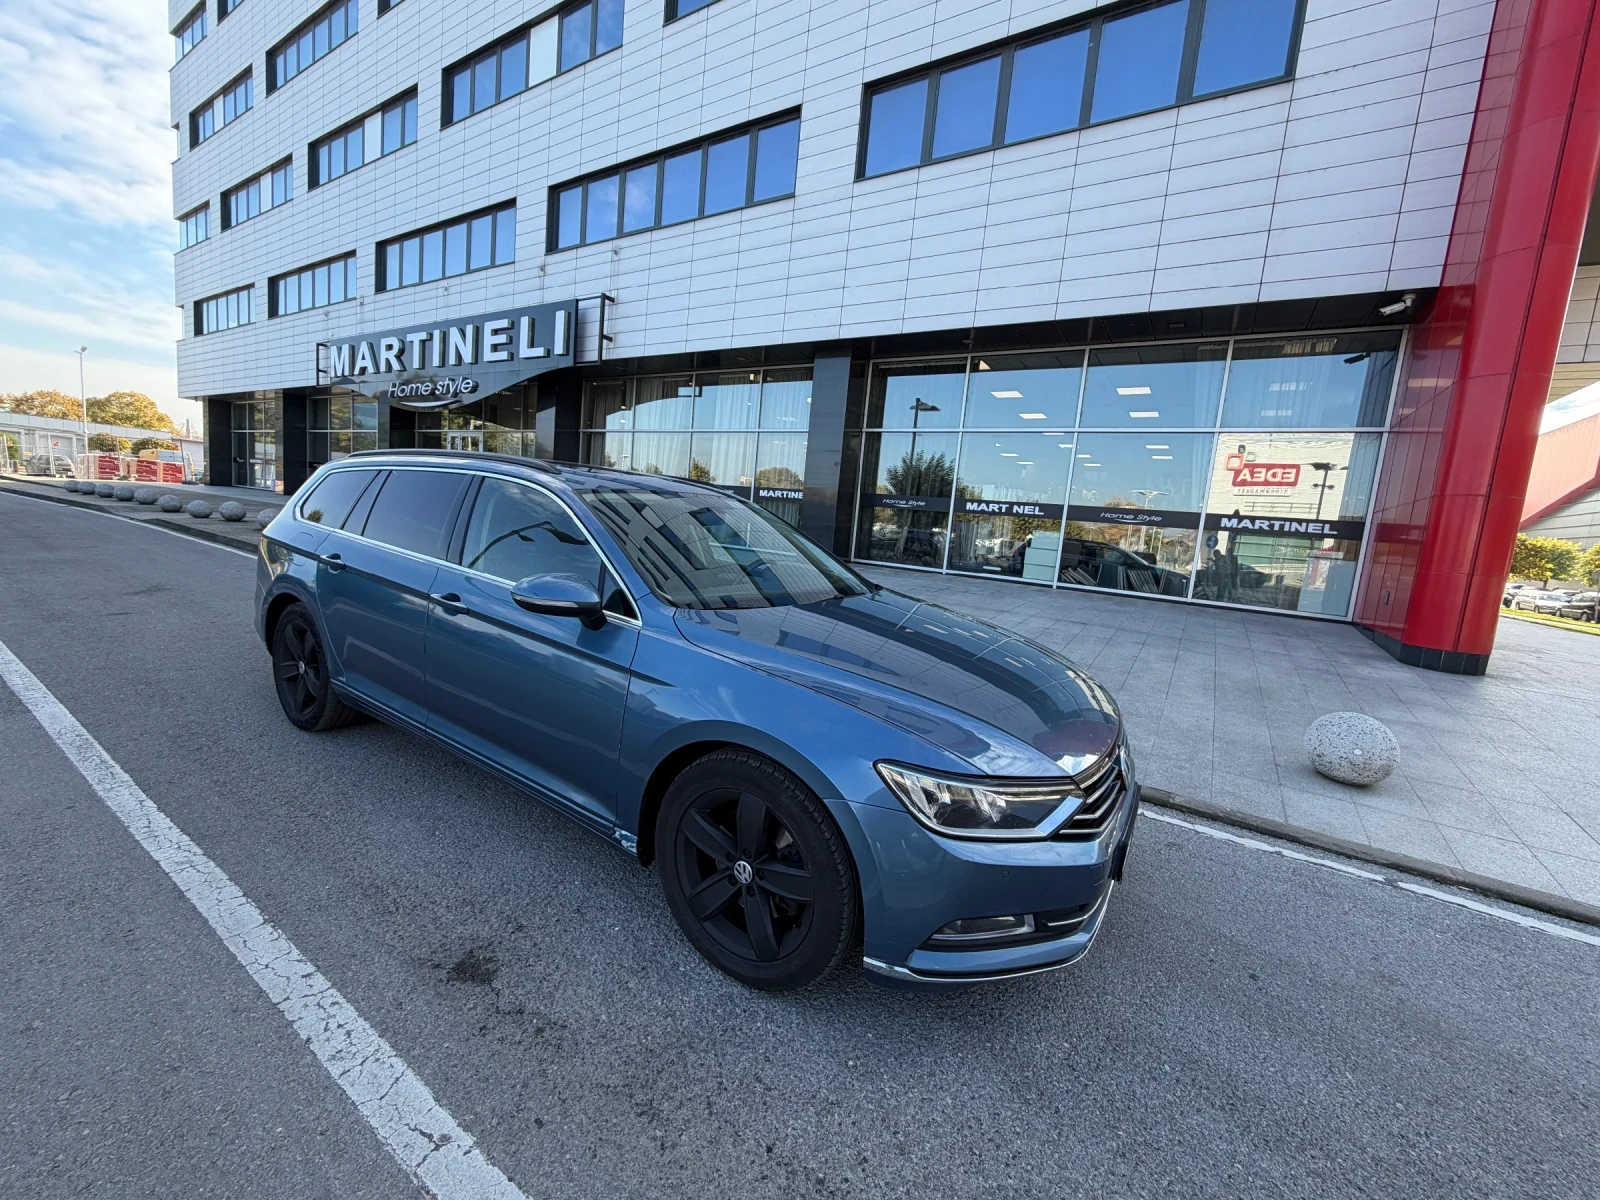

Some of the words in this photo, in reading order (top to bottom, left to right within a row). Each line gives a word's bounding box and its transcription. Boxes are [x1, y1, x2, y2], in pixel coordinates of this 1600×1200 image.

[330, 310, 569, 378] MARTINELI
[388, 381, 432, 398] Home
[435, 376, 473, 398] style
[1100, 511, 1134, 520] Home
[1136, 514, 1163, 522] Style
[1220, 517, 1338, 535] MARTINEL
